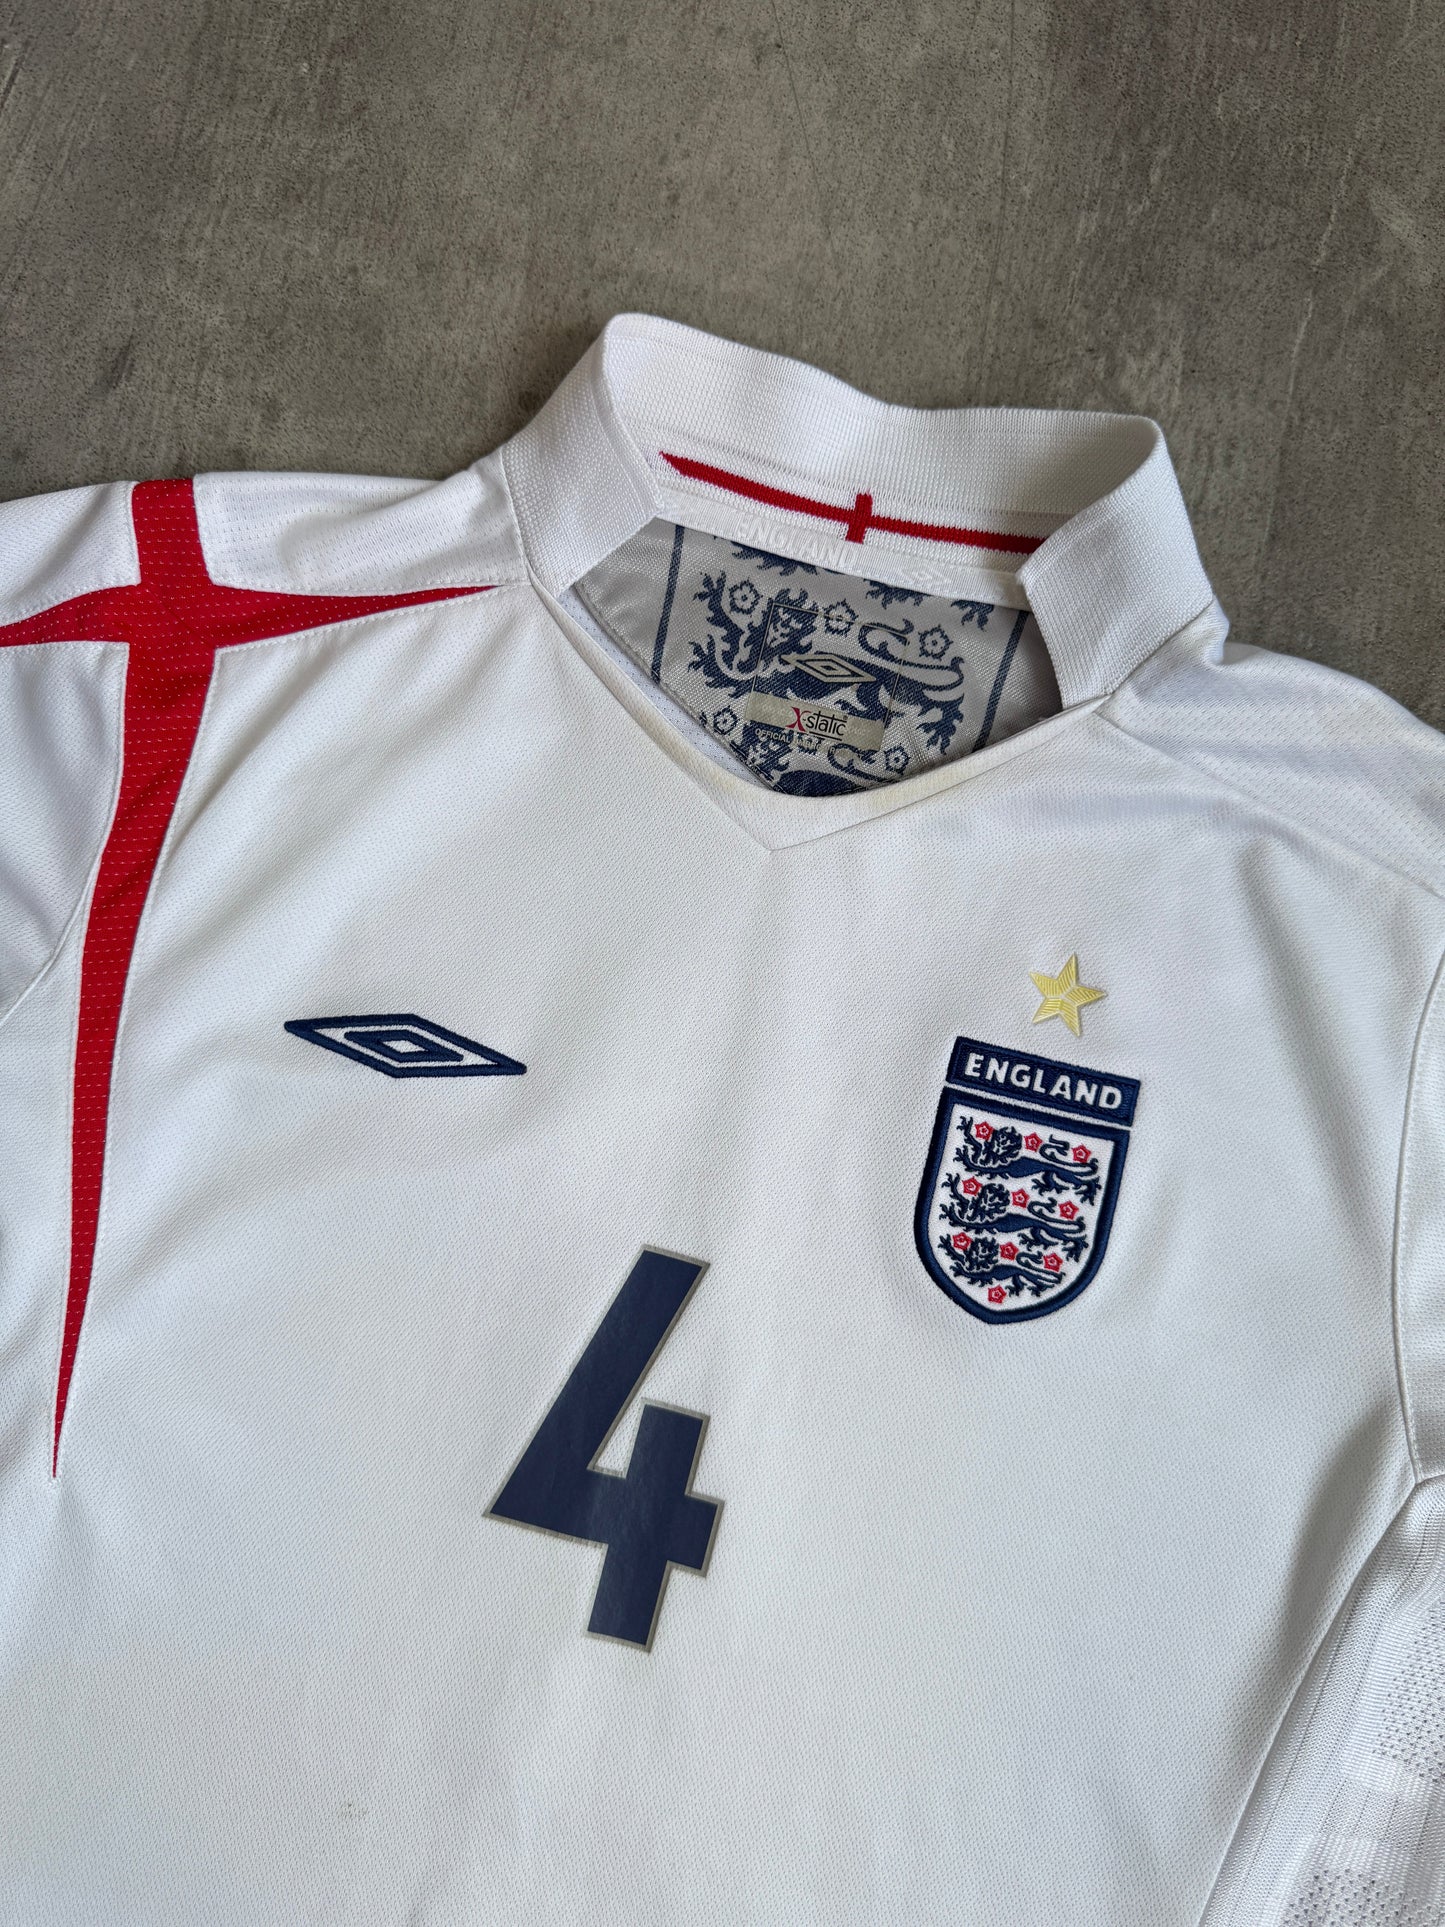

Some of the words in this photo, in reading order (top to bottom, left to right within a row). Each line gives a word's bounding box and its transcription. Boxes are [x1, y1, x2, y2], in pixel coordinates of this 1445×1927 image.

[734, 516, 857, 567] ENGLAND
[755, 728, 791, 743] OFFICIAL
[964, 1053, 1123, 1110] ENGLAND
[482, 1243, 725, 1653] 4
